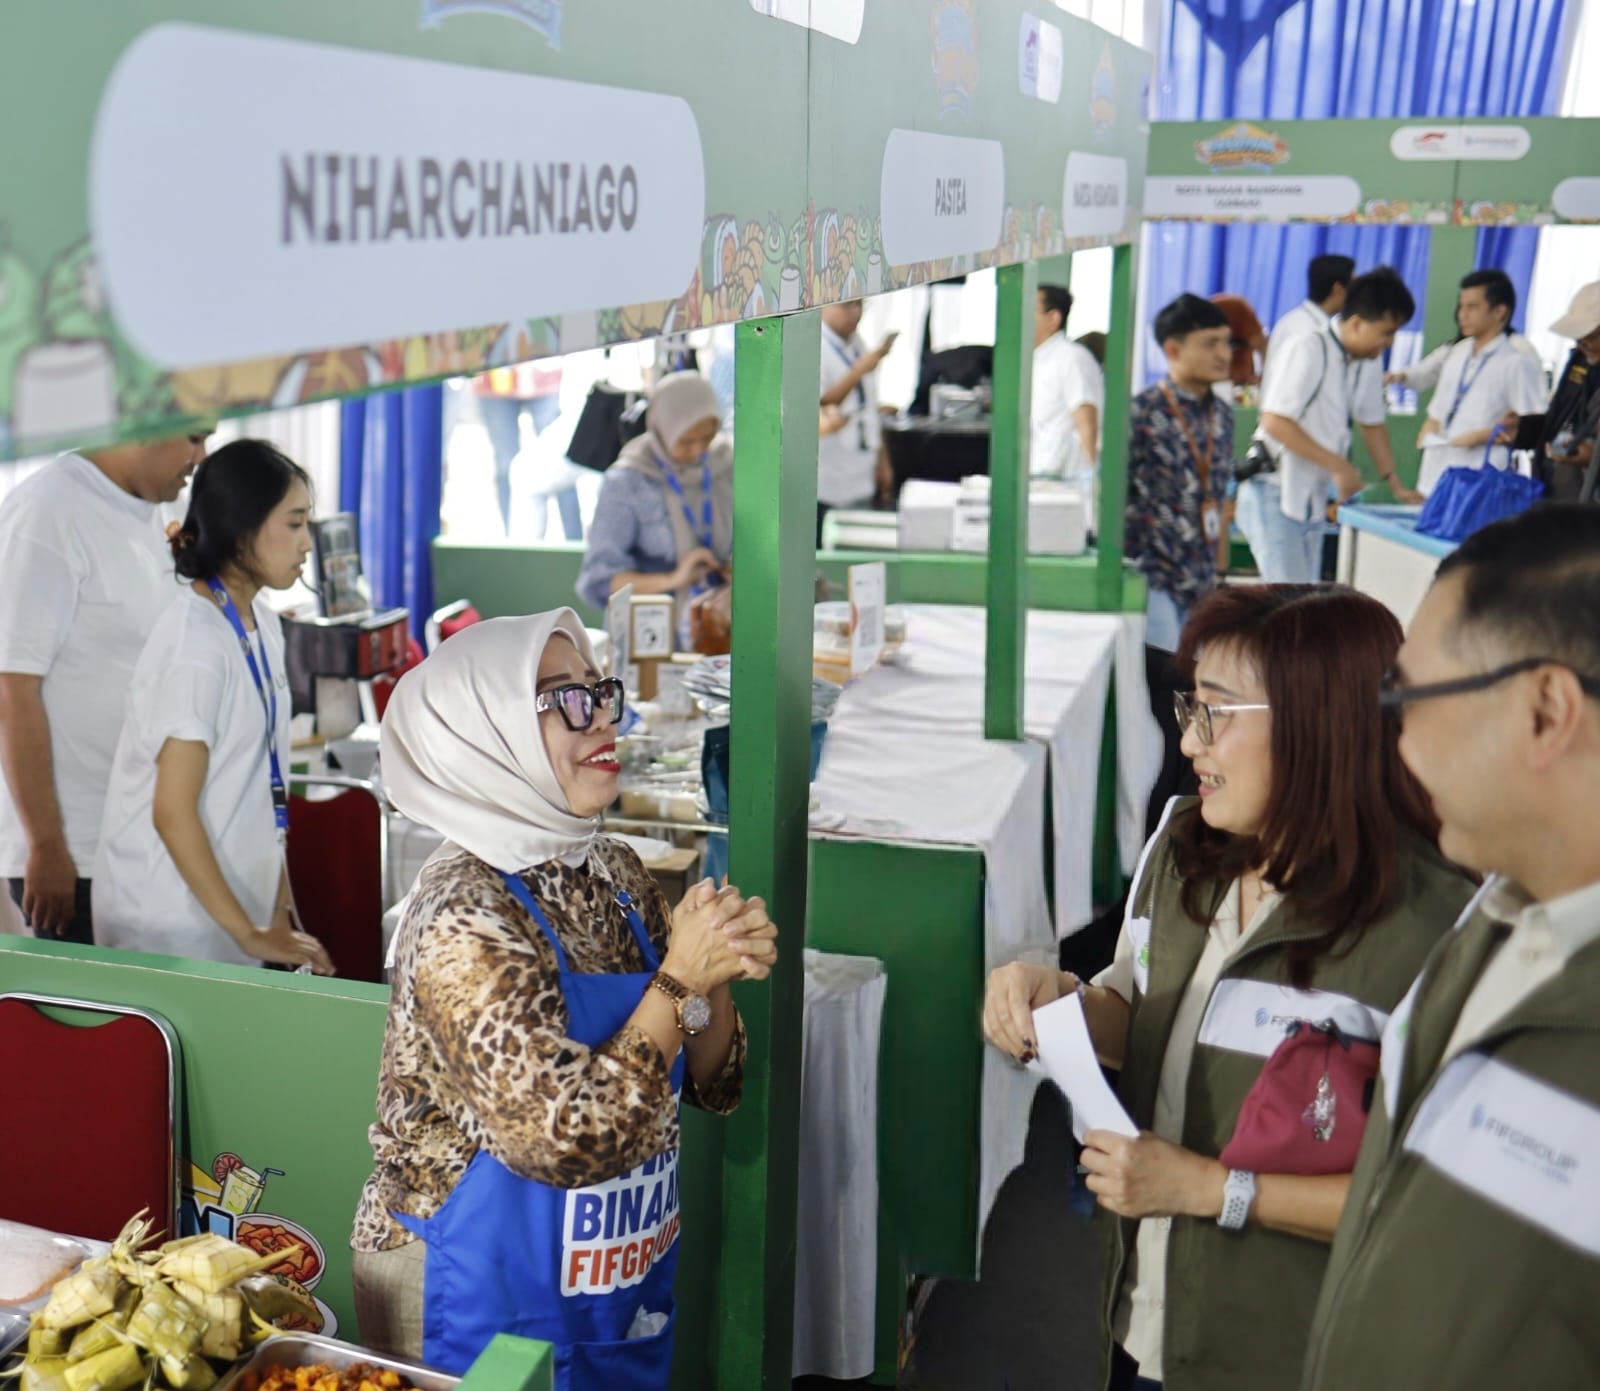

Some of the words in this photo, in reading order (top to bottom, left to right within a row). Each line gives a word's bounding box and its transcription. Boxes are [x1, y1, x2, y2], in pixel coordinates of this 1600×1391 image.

[279, 150, 638, 245] NIHARCHANIAGO
[934, 177, 967, 217] PASTEA
[567, 1211, 680, 1288] FIFGRUP
